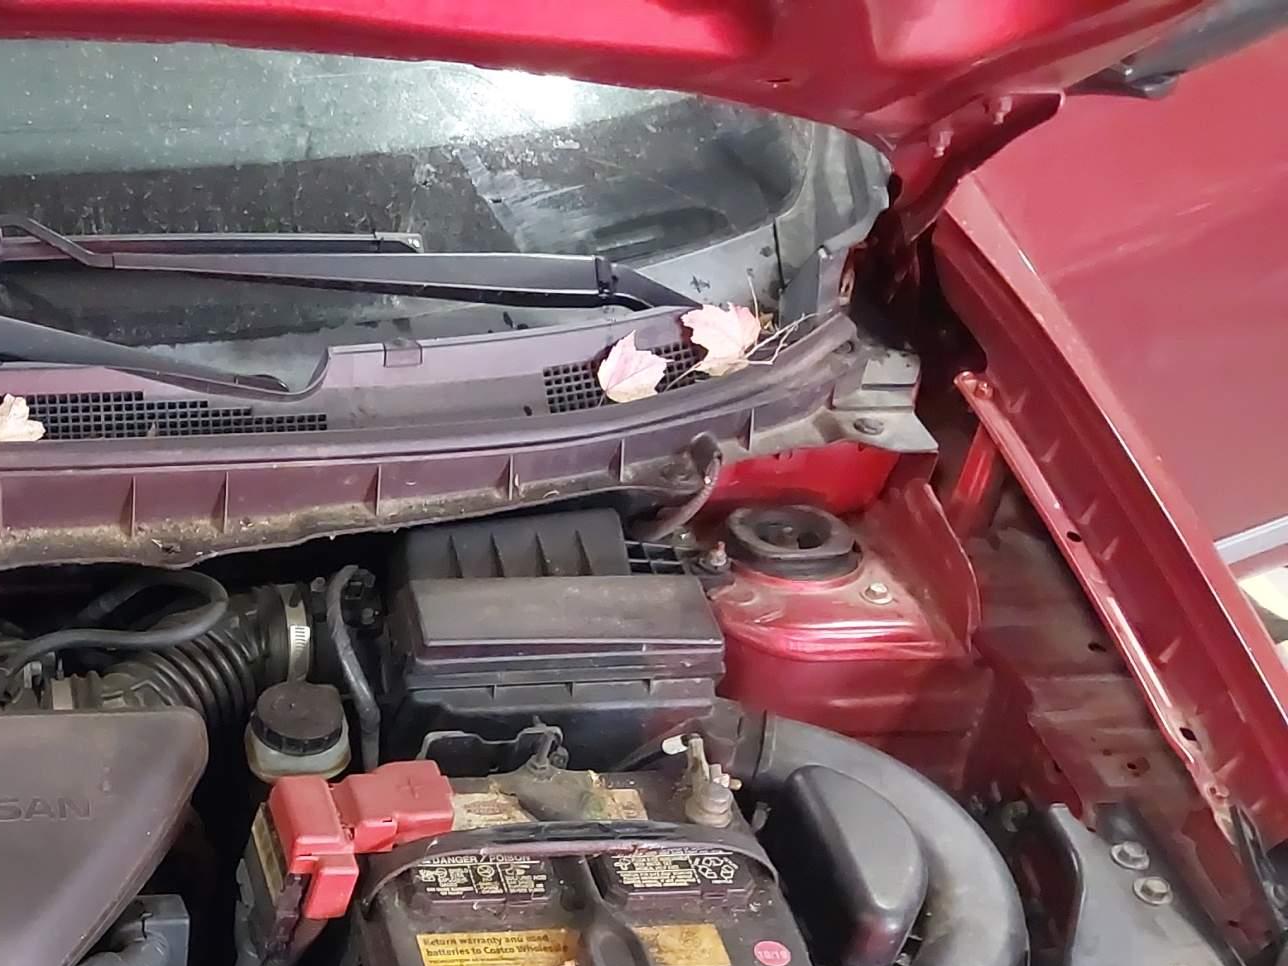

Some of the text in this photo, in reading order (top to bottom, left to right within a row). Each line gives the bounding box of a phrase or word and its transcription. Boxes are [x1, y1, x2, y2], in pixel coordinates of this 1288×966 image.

[432, 855, 478, 865] DANGER
[489, 855, 531, 863] POISON
[423, 933, 549, 946] Return warranty and used
[426, 944, 569, 957] batteries to Costco Wholesale
